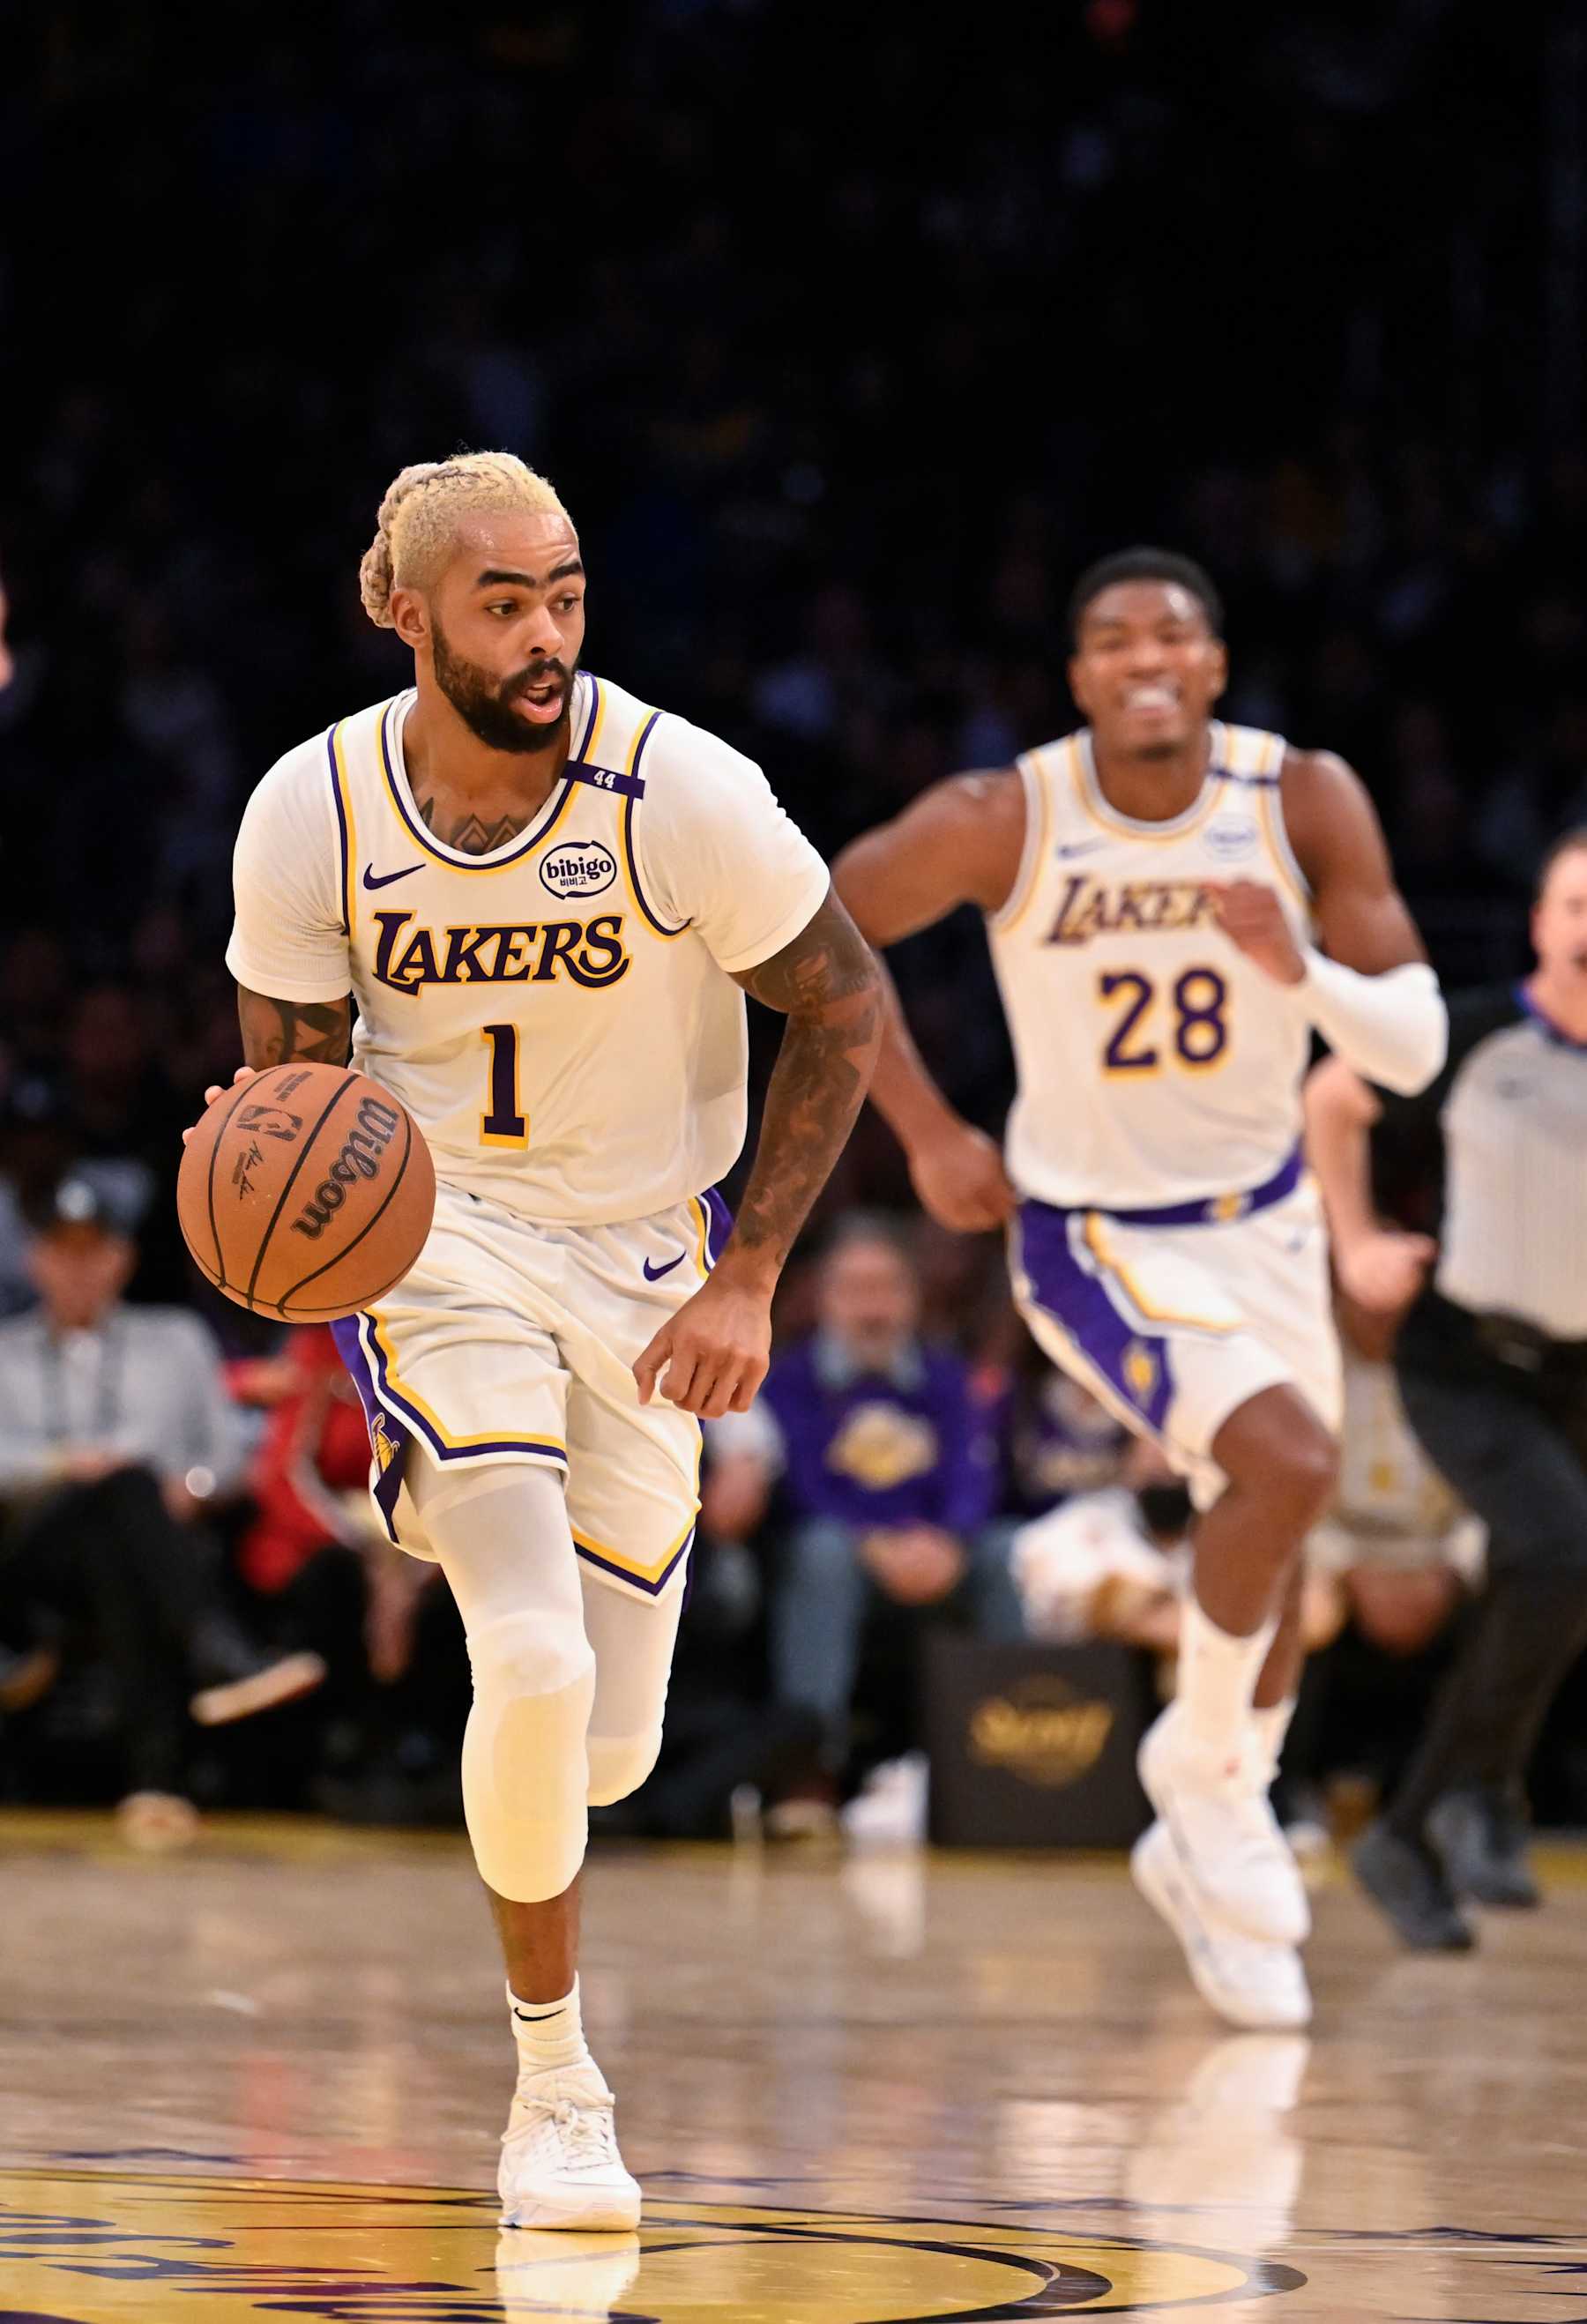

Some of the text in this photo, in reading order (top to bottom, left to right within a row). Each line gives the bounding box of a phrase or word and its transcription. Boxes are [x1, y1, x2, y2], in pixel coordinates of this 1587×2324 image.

[594, 770, 616, 789] 44
[546, 856, 612, 880] bibigo
[559, 876, 587, 887] 비비고
[1043, 875, 1222, 947] LAKER
[373, 910, 631, 997] LAKERS
[1100, 968, 1227, 1069] 28
[481, 1024, 526, 1145] 1
[290, 1096, 399, 1240] Wilson
